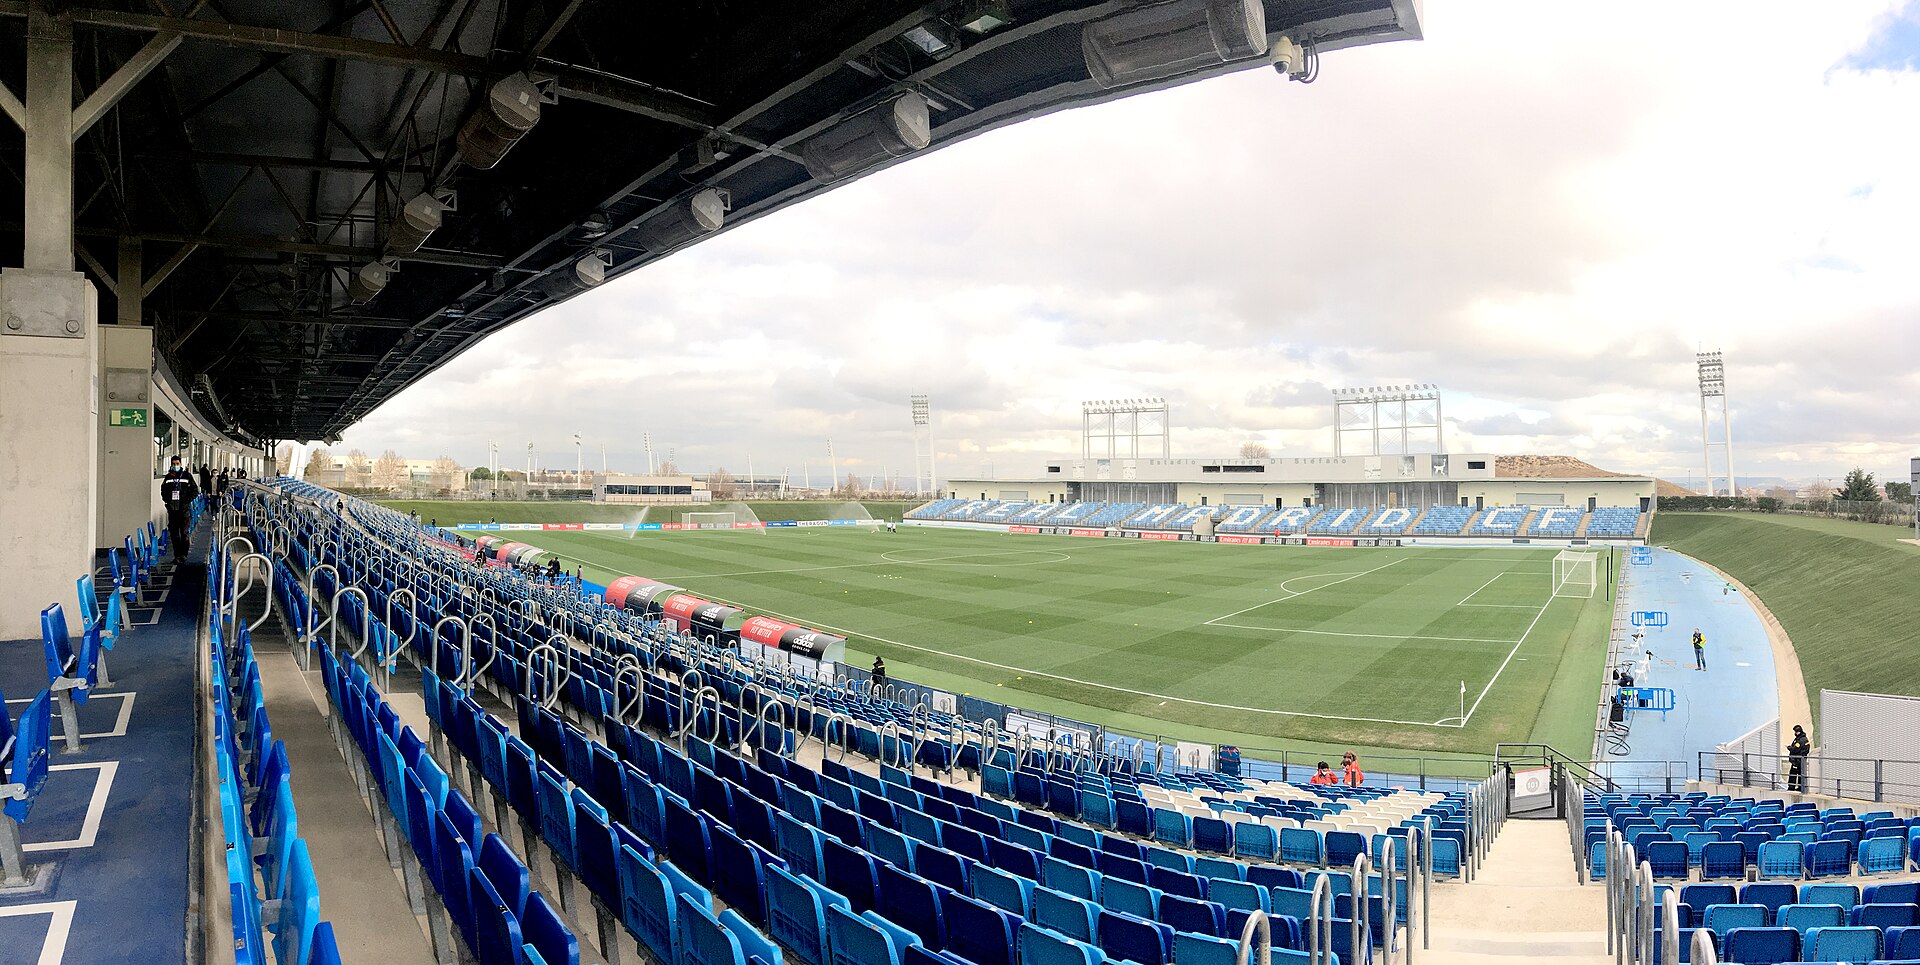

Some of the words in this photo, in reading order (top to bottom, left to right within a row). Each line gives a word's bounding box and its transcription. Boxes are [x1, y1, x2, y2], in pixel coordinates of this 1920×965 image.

[952, 501, 1083, 519] REAL
[1482, 508, 1578, 529] CF
[752, 618, 784, 632] Emirates
[793, 637, 814, 649] adidas
